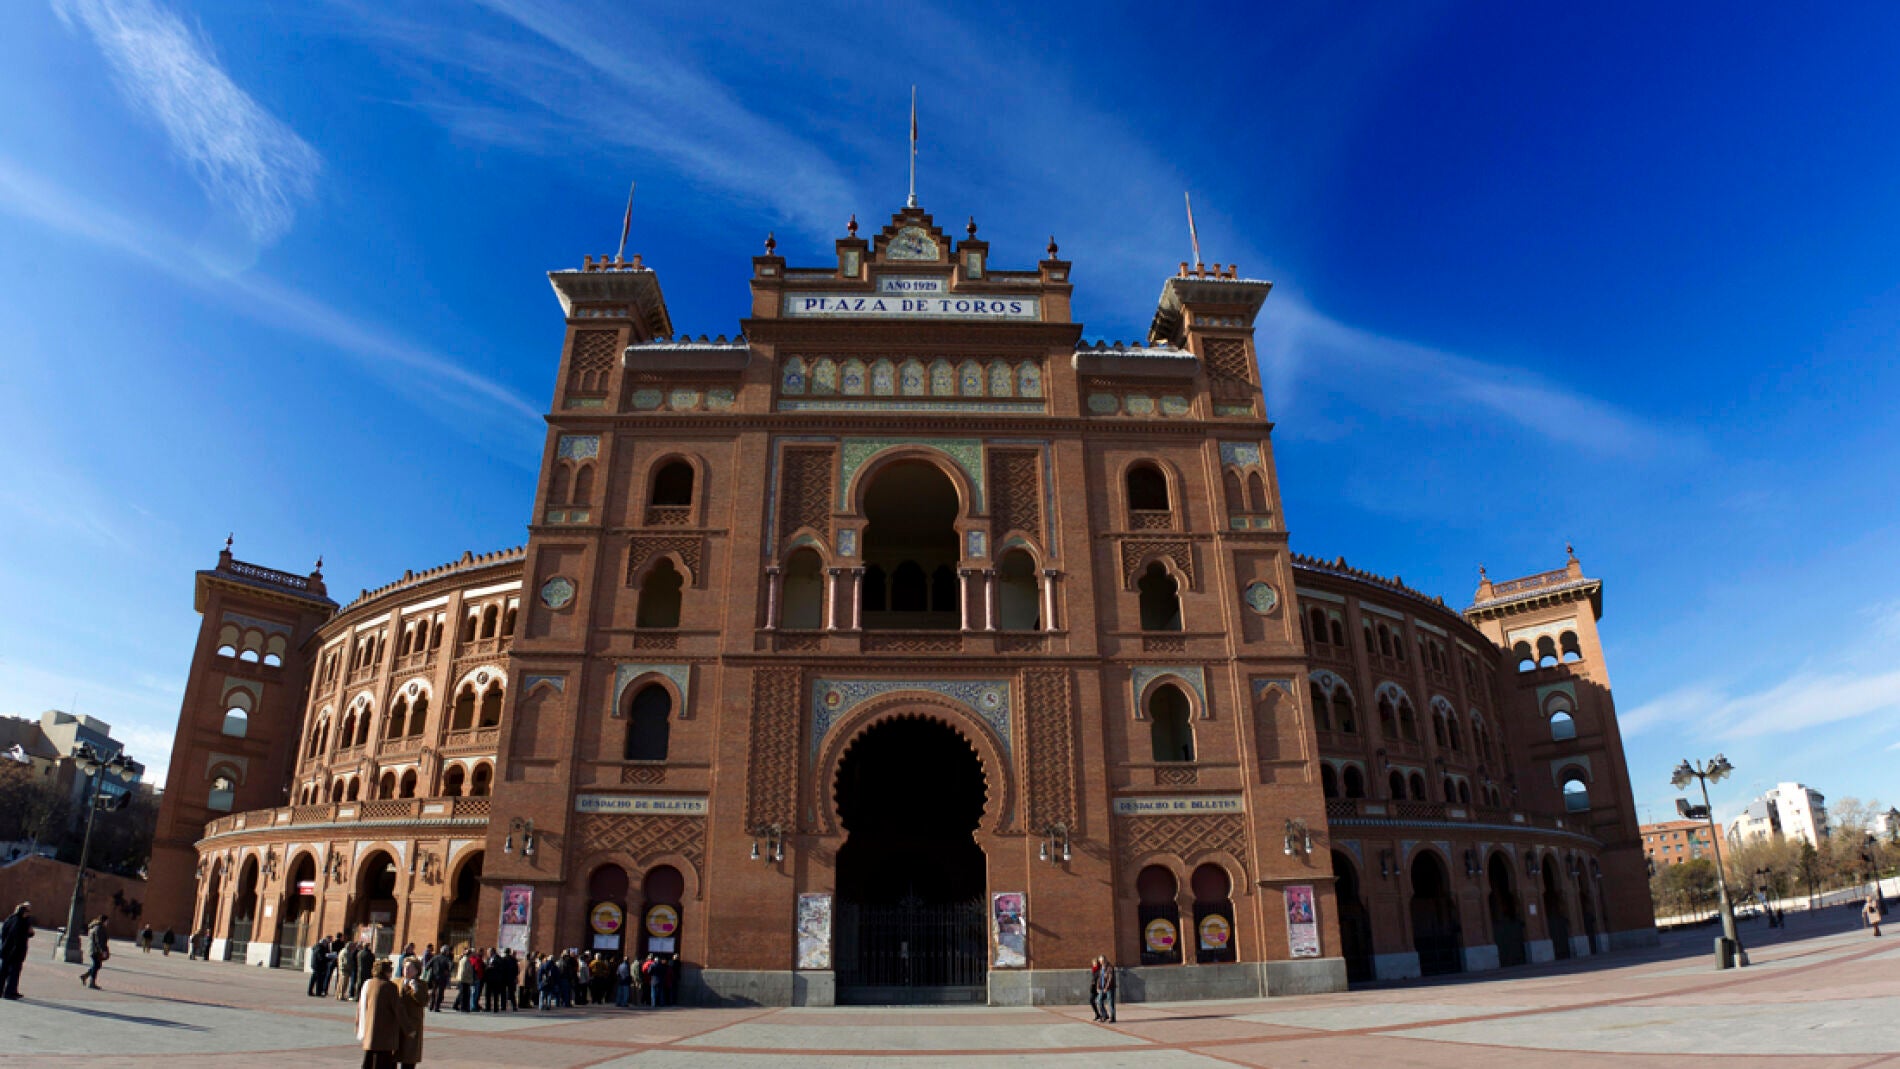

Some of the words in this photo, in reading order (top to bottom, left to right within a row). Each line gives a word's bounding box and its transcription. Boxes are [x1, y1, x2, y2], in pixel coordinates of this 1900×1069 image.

[886, 280, 911, 291] AÑO
[913, 281, 937, 291] 1929
[805, 298, 888, 312] PLAZA
[902, 299, 928, 312] DE
[938, 299, 1022, 314] TOROS
[581, 799, 631, 808] DESPACHO
[635, 800, 649, 809] DE
[652, 800, 702, 810] BILLETES
[1120, 801, 1169, 810] DESPACHO
[1173, 801, 1187, 809] DE
[1191, 800, 1237, 809] BILLETES
